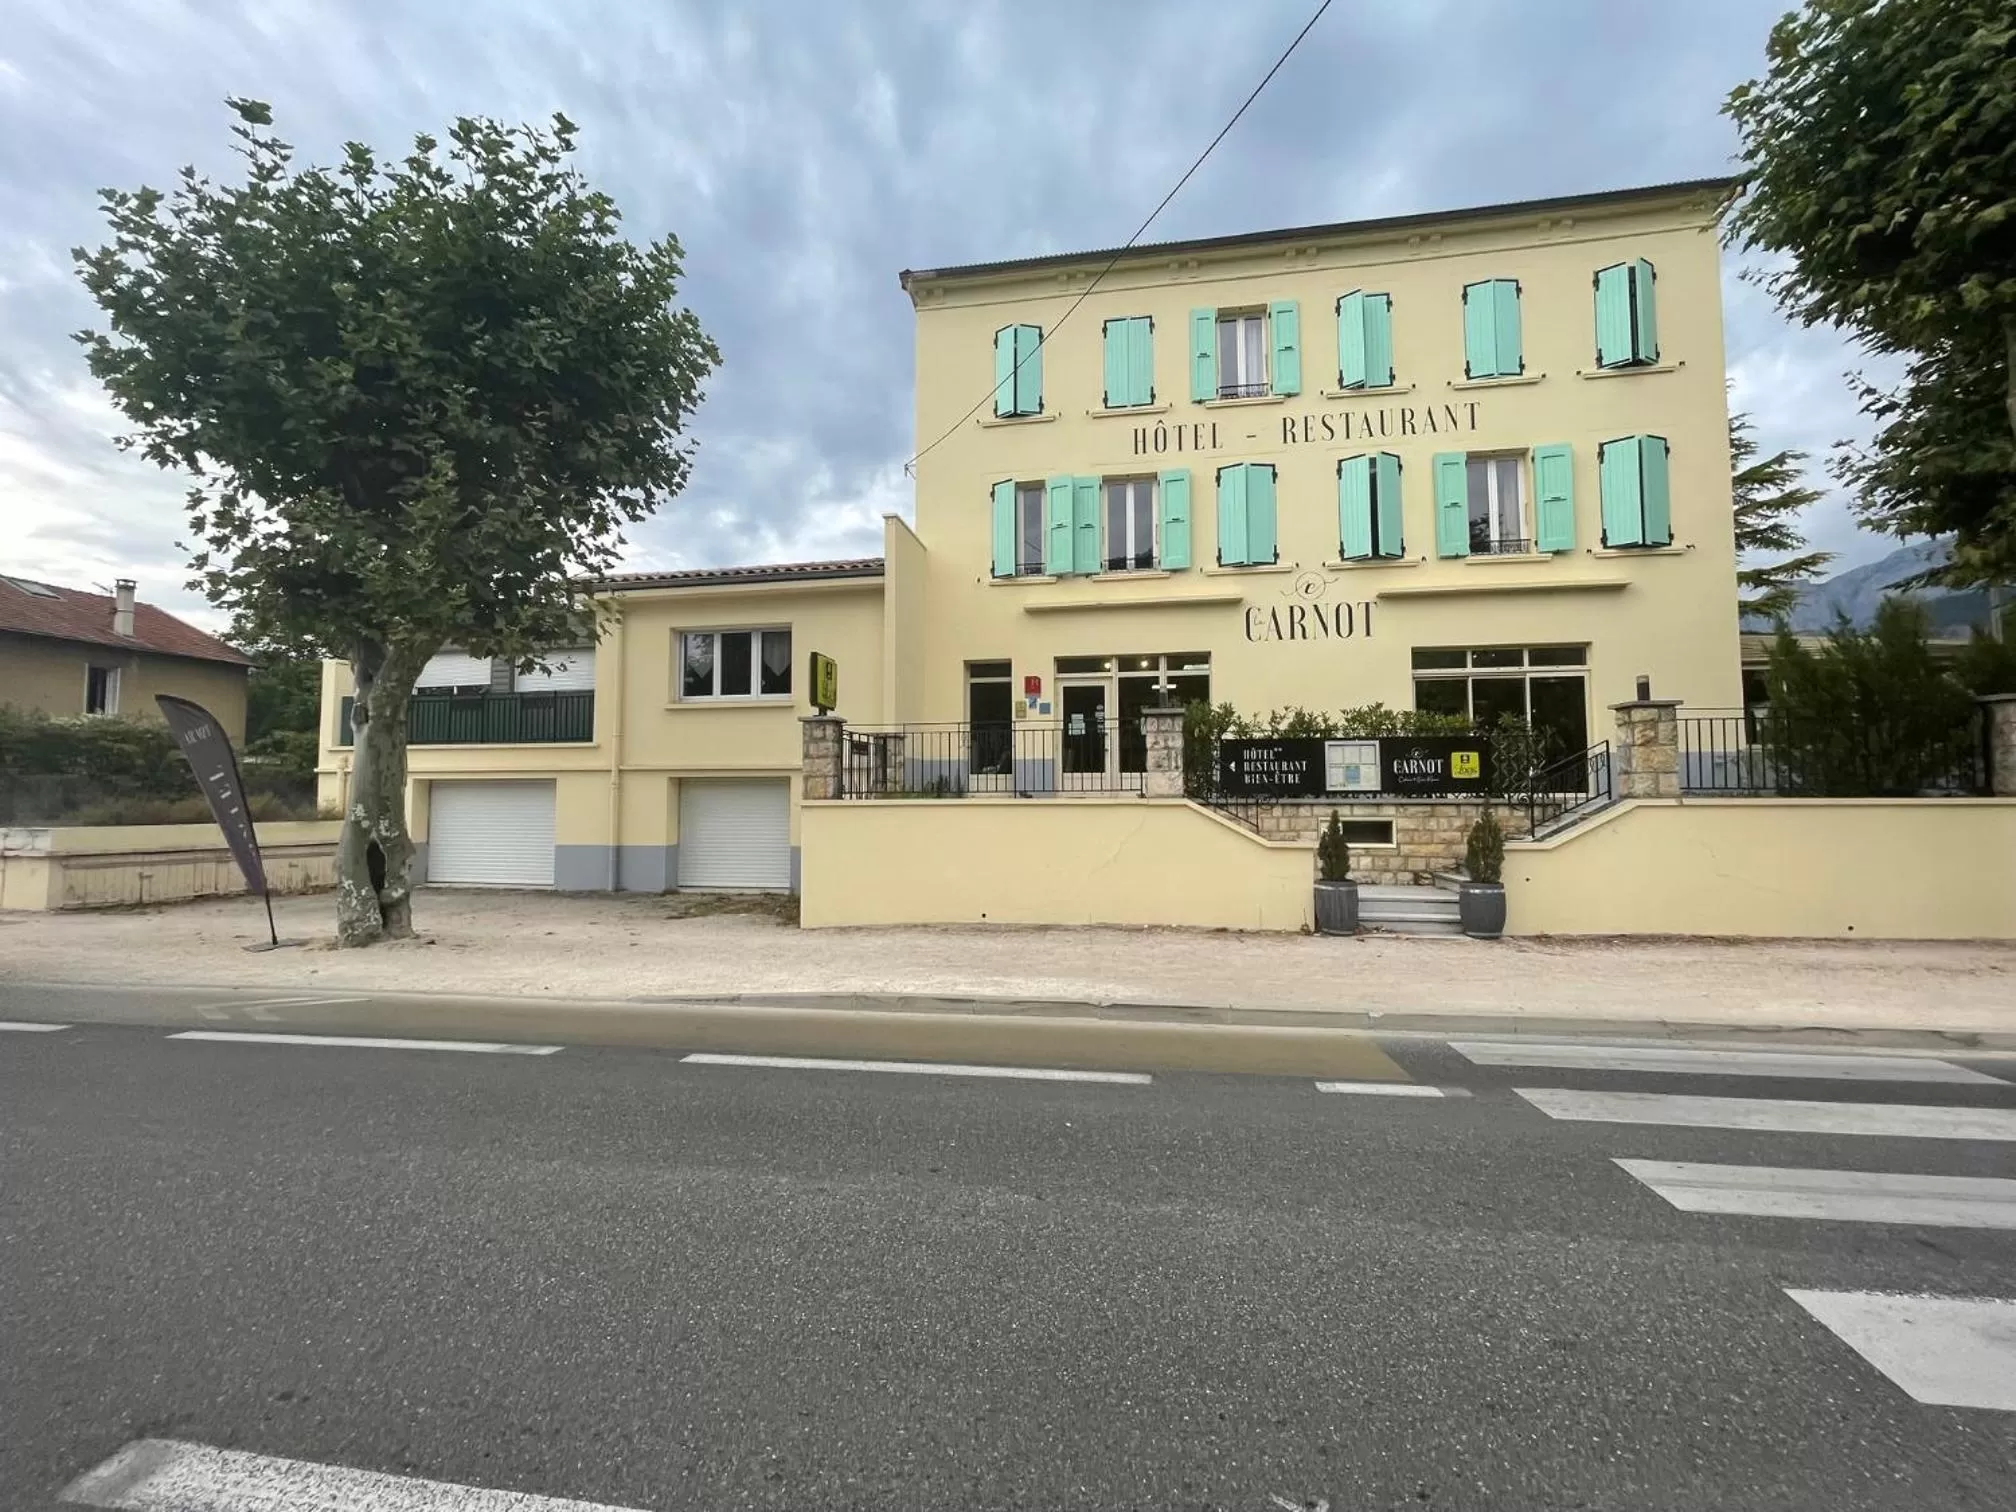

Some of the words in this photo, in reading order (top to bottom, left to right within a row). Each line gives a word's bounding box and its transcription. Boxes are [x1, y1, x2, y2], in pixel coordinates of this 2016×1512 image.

[1134, 419, 1223, 455] HÔTEL
[1282, 401, 1480, 445] RESTAURANT
[1245, 601, 1378, 642] CARNOT
[1243, 760, 1307, 772] RESTAURANT
[1393, 758, 1445, 774] CARNOT
